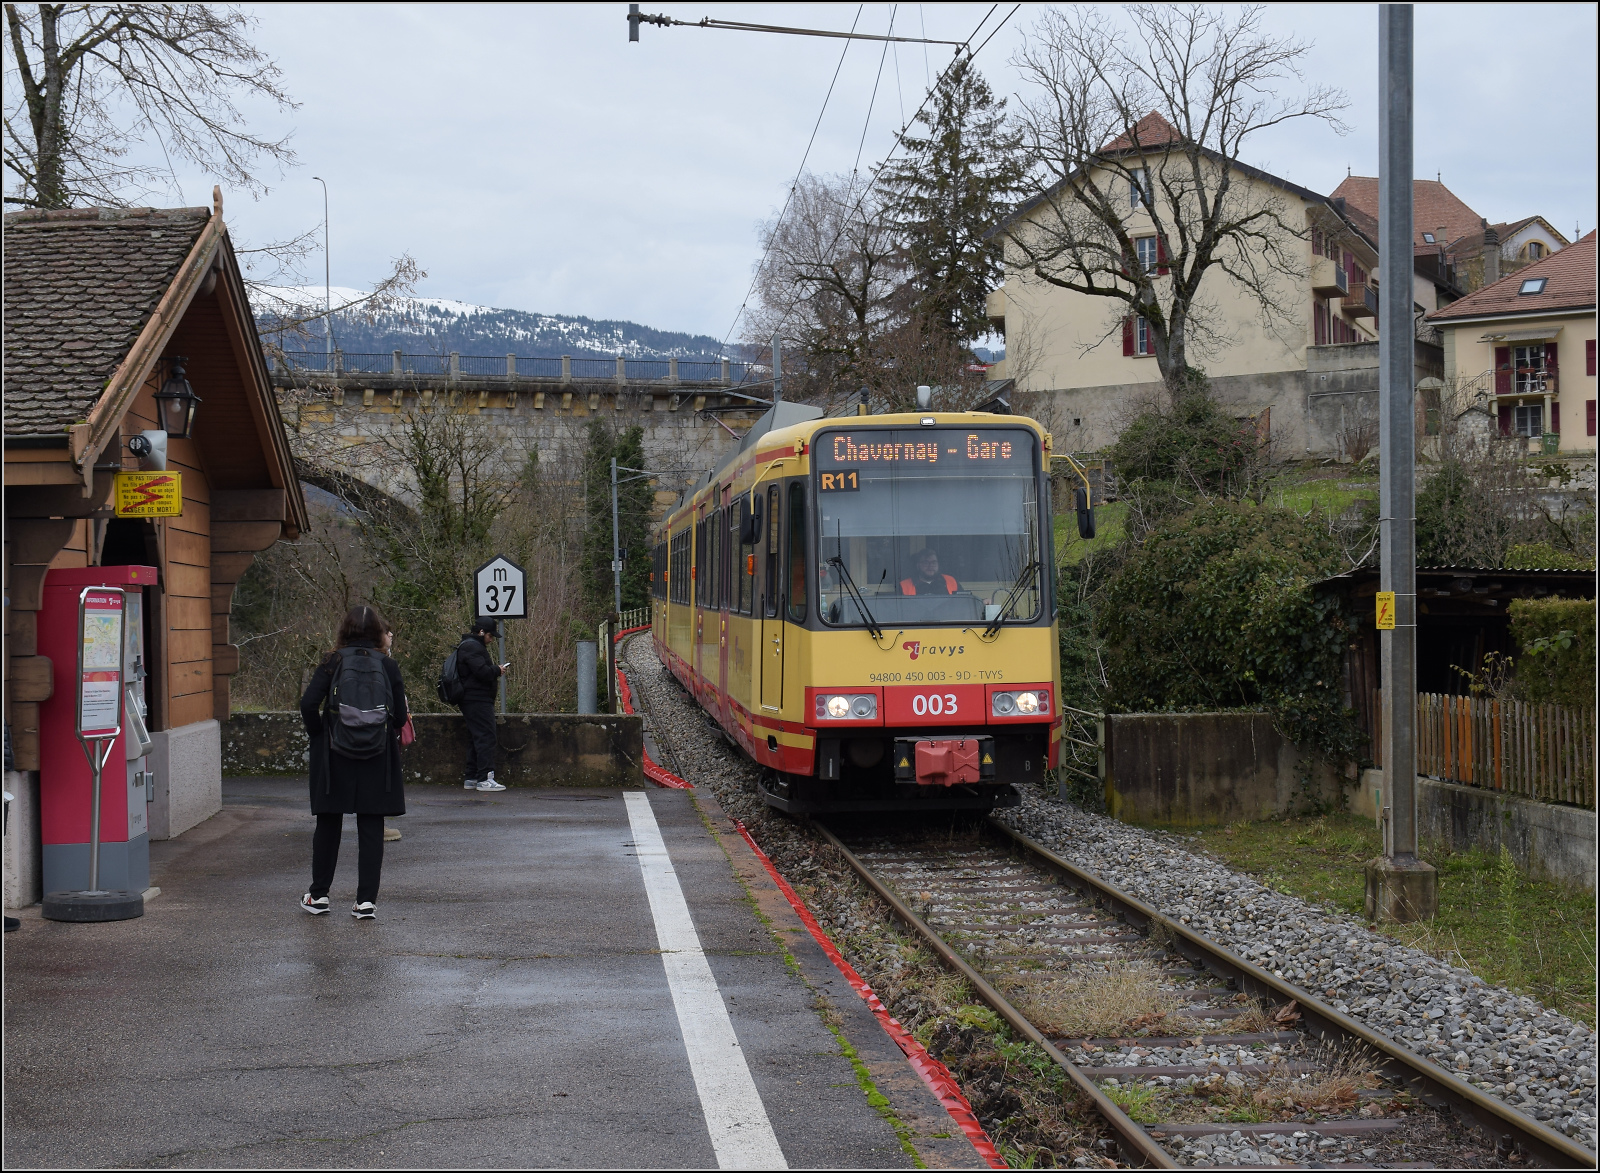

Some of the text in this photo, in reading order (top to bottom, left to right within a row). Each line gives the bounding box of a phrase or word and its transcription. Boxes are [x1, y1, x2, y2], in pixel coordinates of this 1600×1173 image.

[834, 436, 938, 462] Chavornay
[967, 434, 1012, 459] Gare
[821, 472, 857, 490] R11
[493, 567, 507, 582] m
[486, 584, 516, 613] 37
[903, 641, 965, 660] travys
[869, 672, 902, 683] 94800
[905, 672, 924, 682] 450
[927, 671, 946, 681] 003
[978, 669, 1004, 680] TVYS
[912, 693, 958, 716] 003
